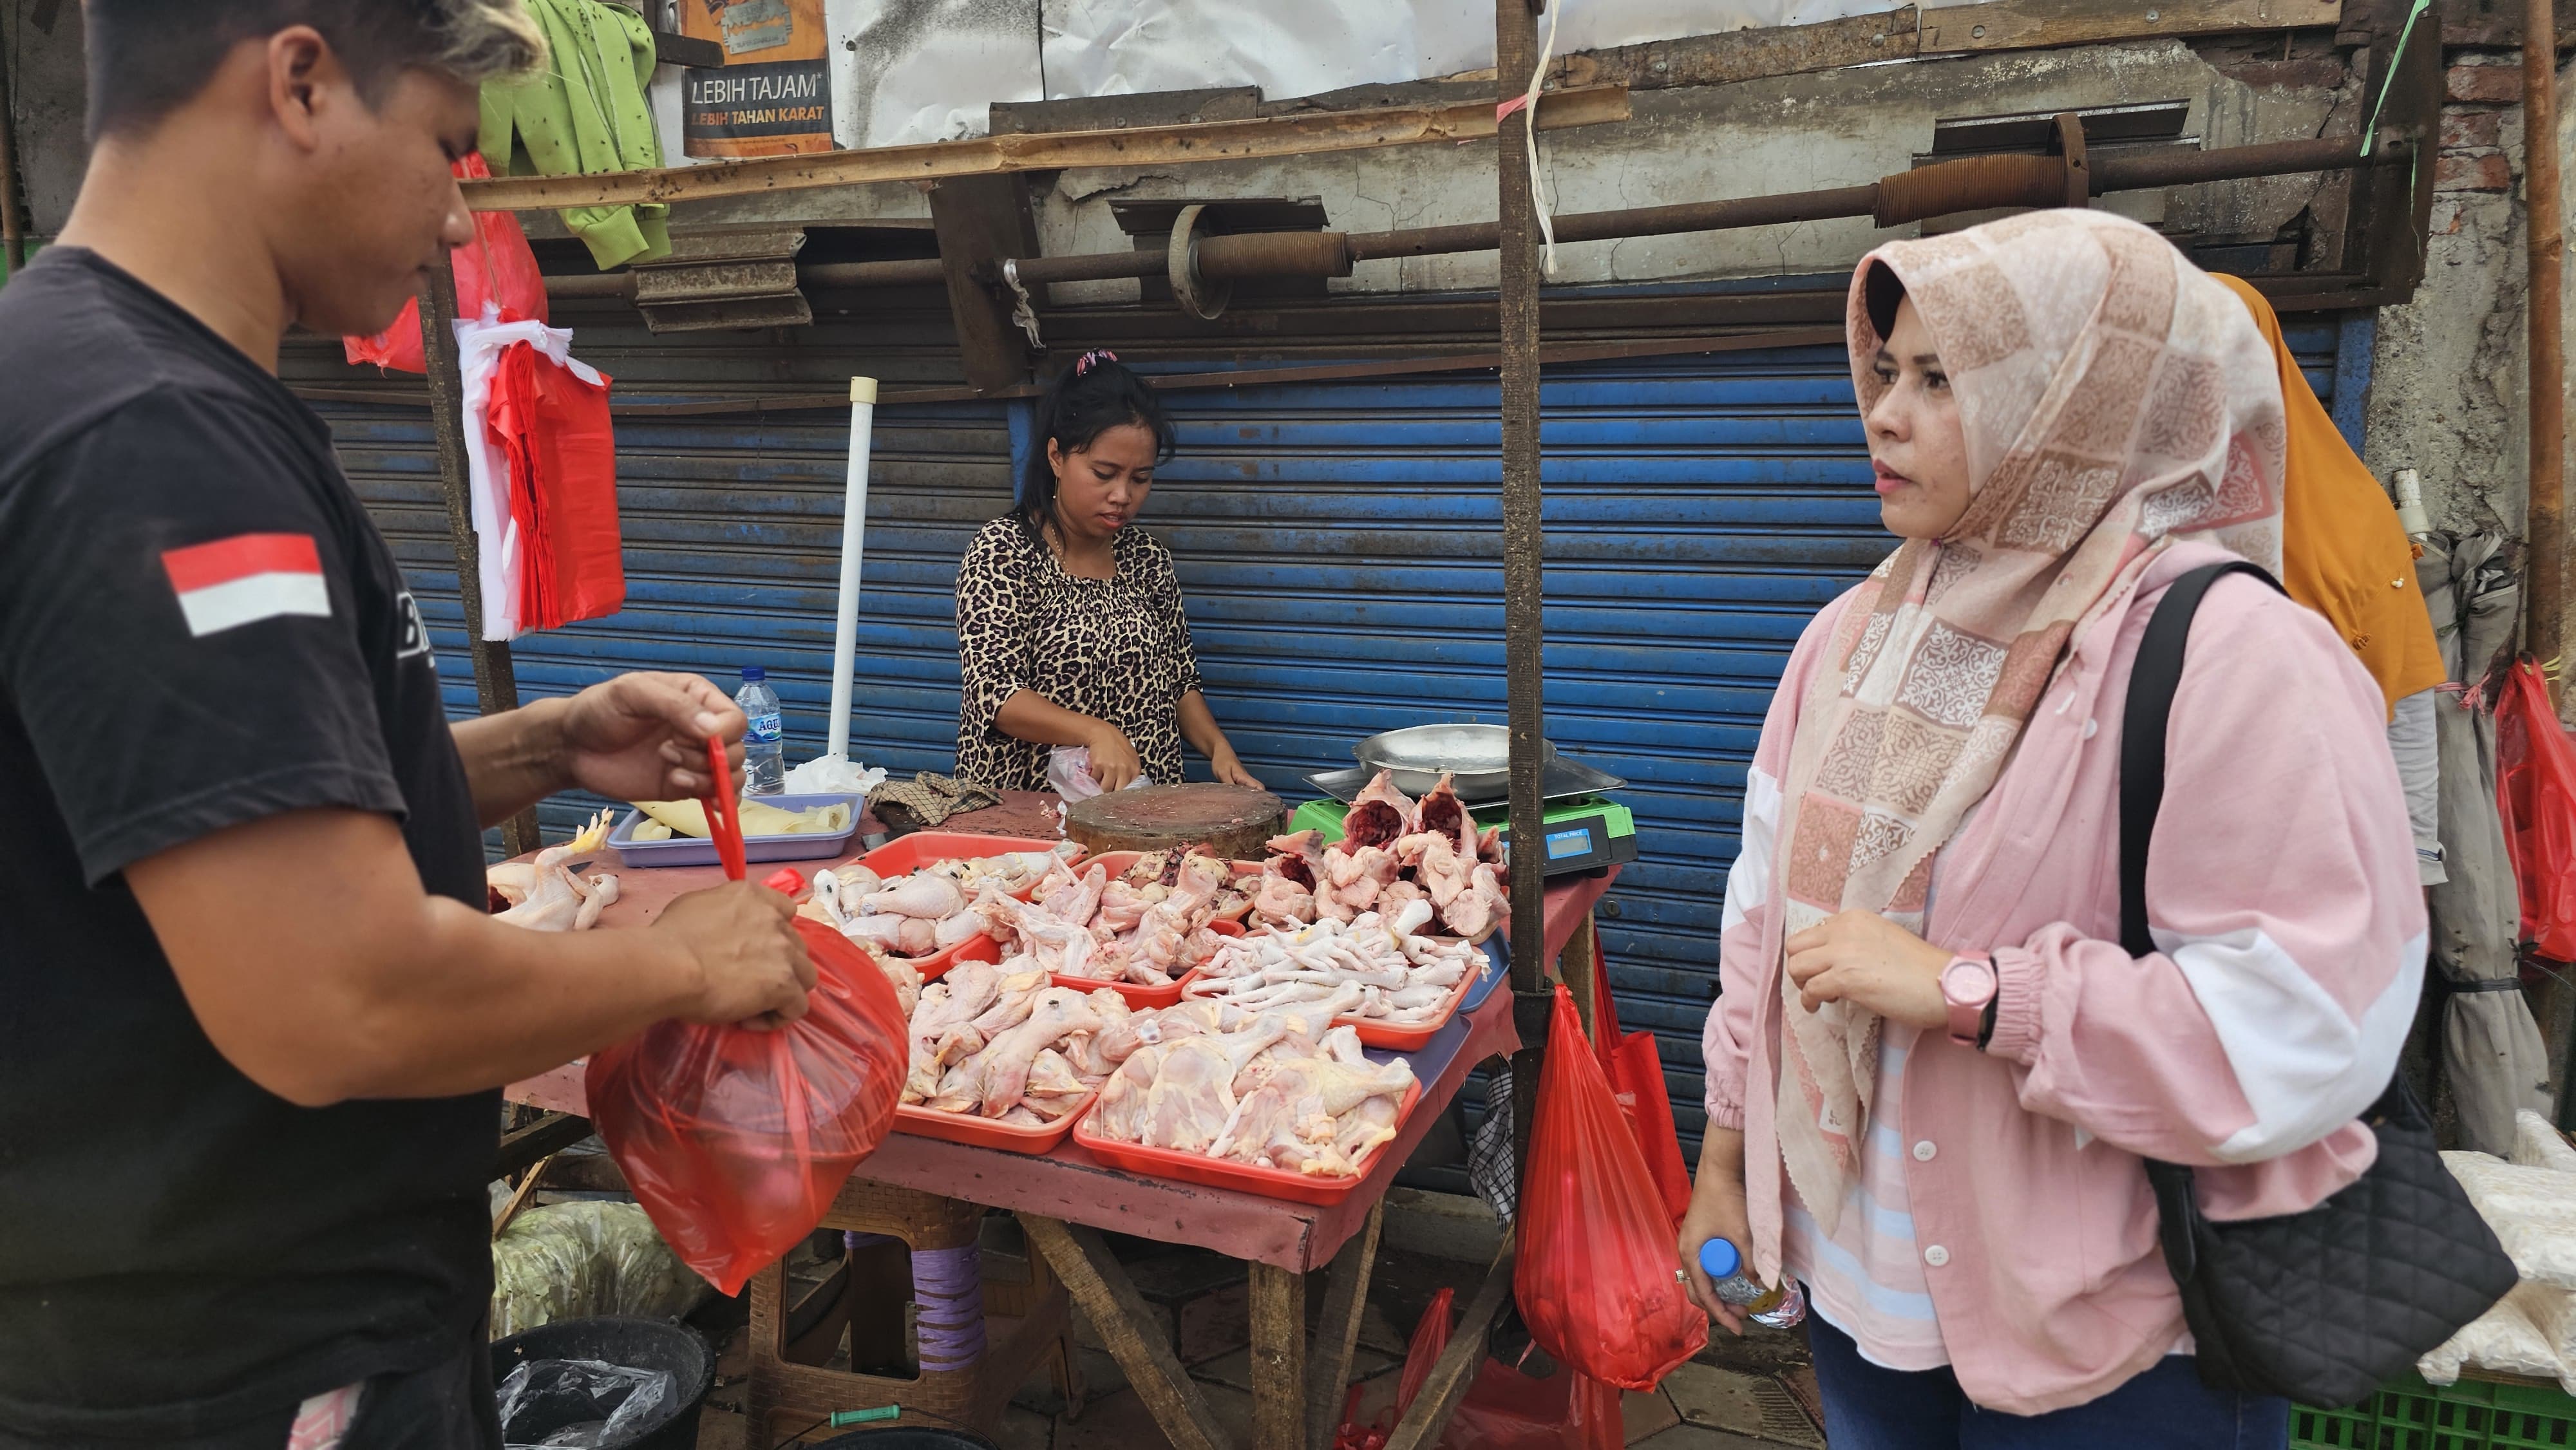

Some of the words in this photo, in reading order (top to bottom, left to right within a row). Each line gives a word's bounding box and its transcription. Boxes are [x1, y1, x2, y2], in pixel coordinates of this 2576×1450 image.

[692, 78, 746, 104] LEBIH
[691, 111, 728, 126] LEBIH
[732, 109, 775, 124] TAHAN
[779, 106, 825, 121] KARAT
